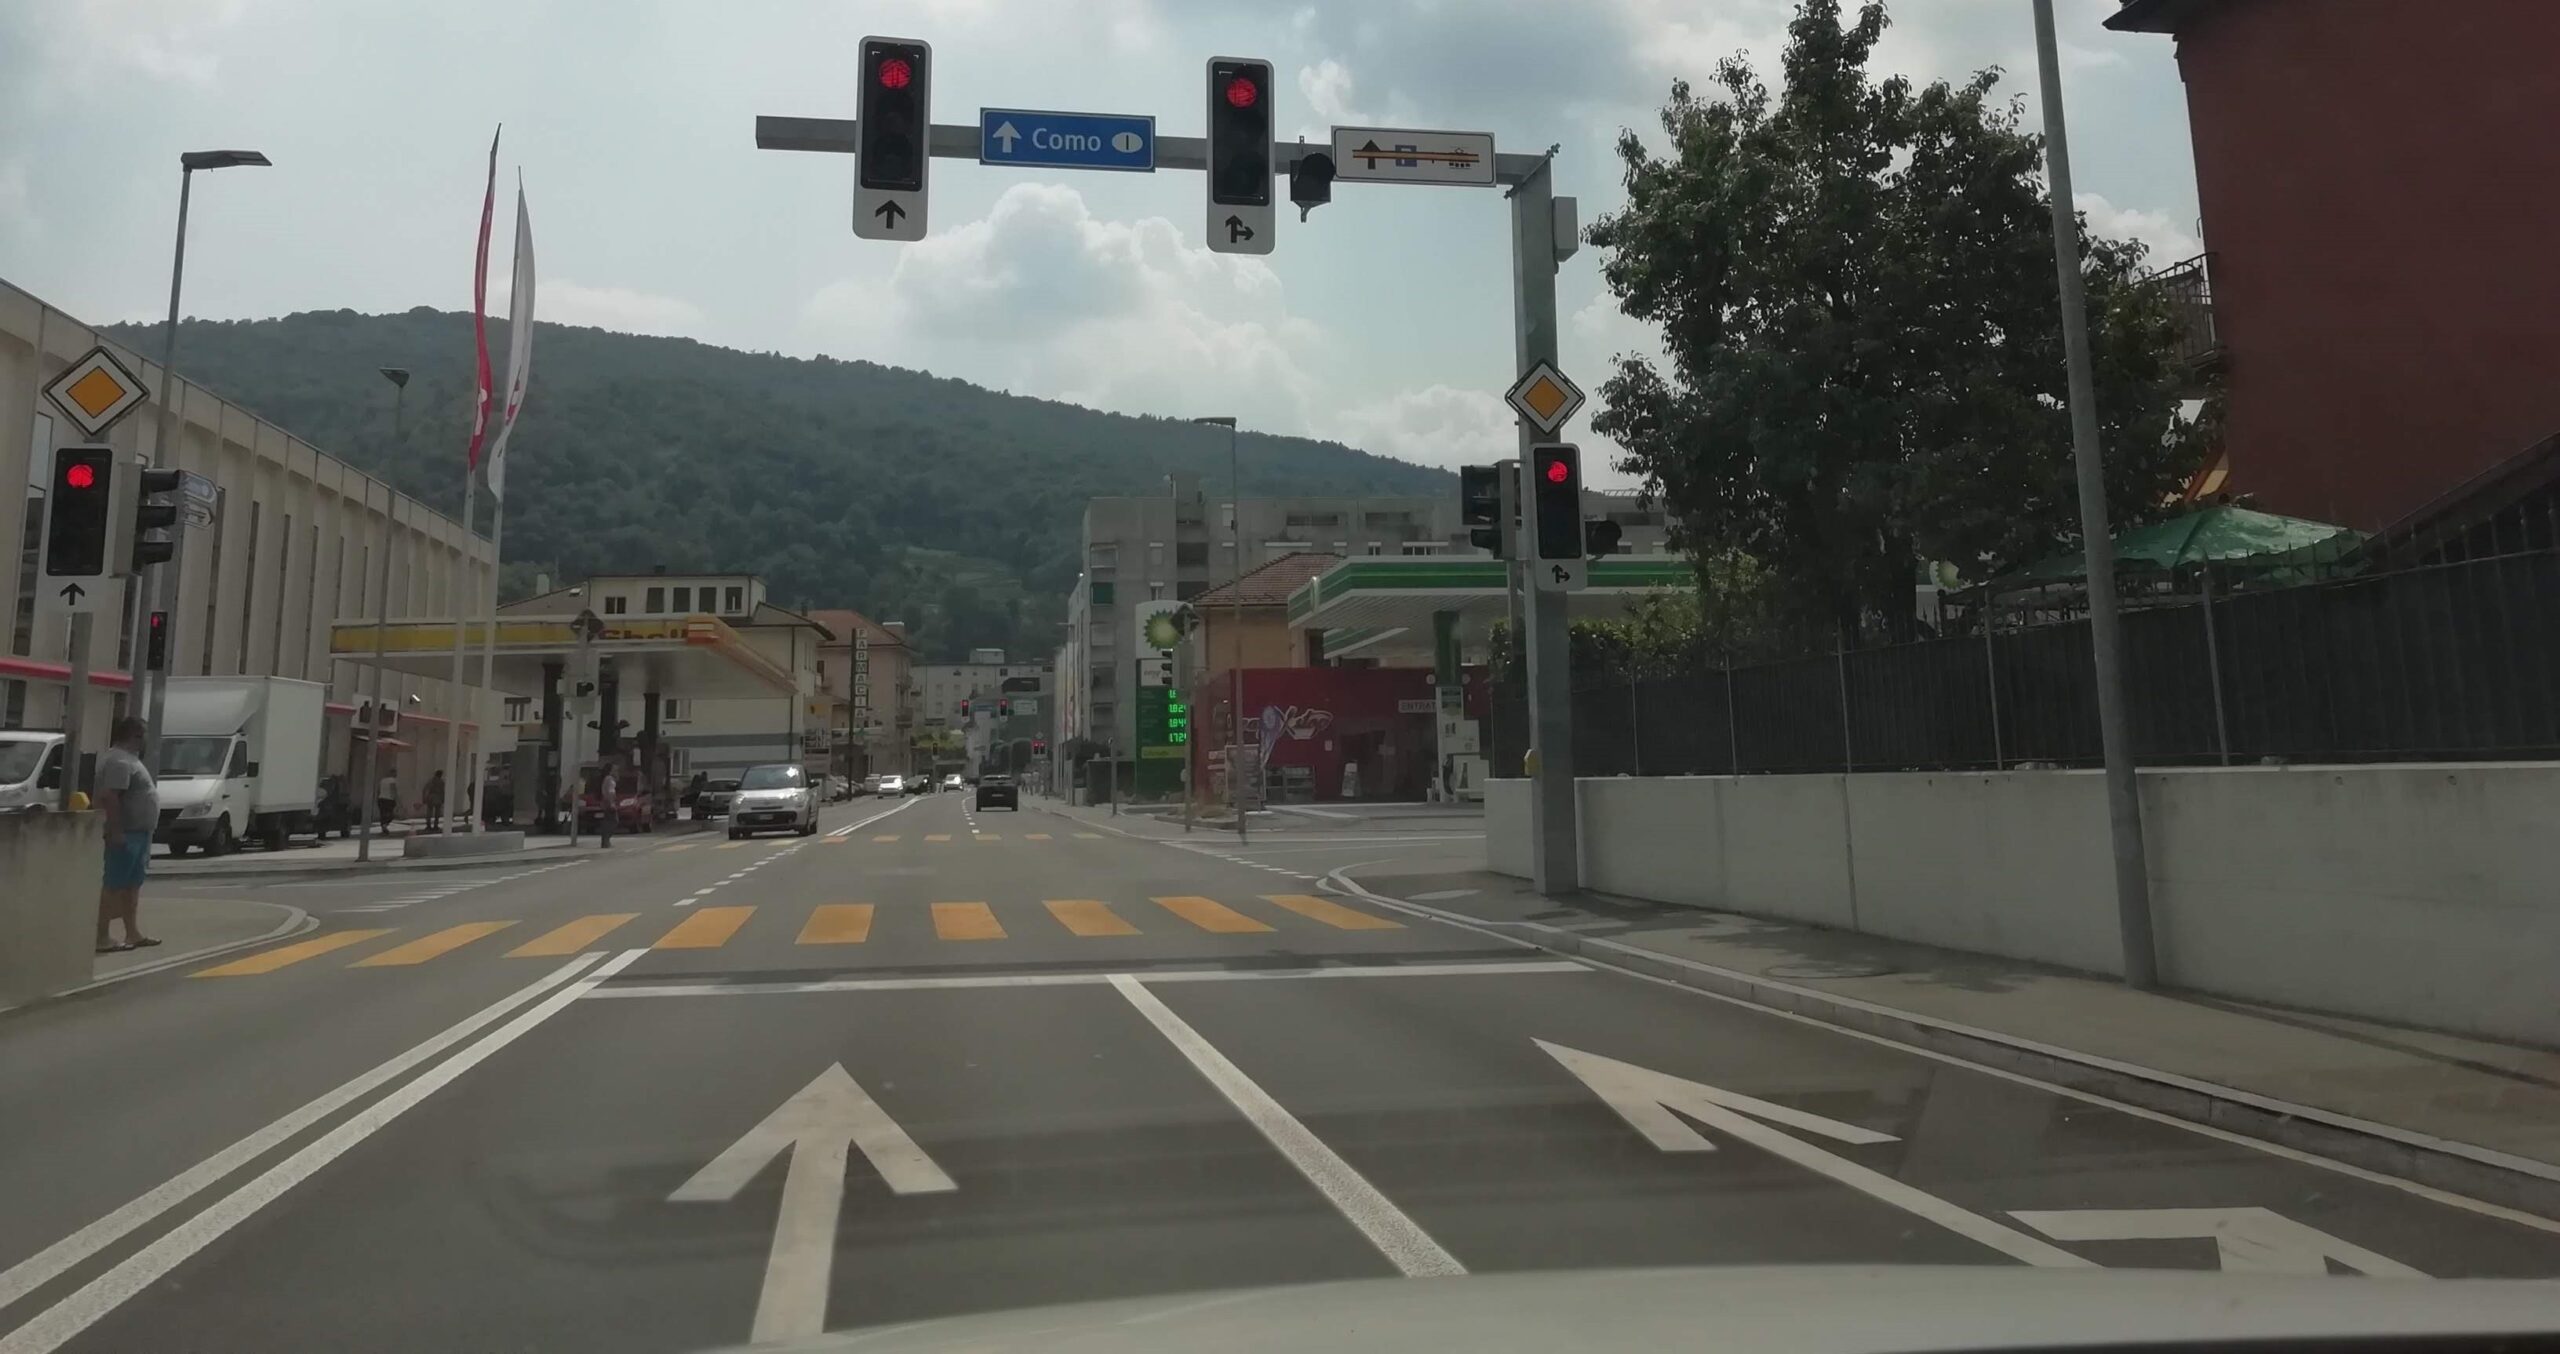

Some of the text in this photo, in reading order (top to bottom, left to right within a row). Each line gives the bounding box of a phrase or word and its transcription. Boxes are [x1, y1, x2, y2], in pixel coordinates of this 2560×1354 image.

[1031, 126, 1102, 152] Como
[856, 629, 866, 717] FARMACIA
[1401, 701, 1437, 711] ENTRAT
